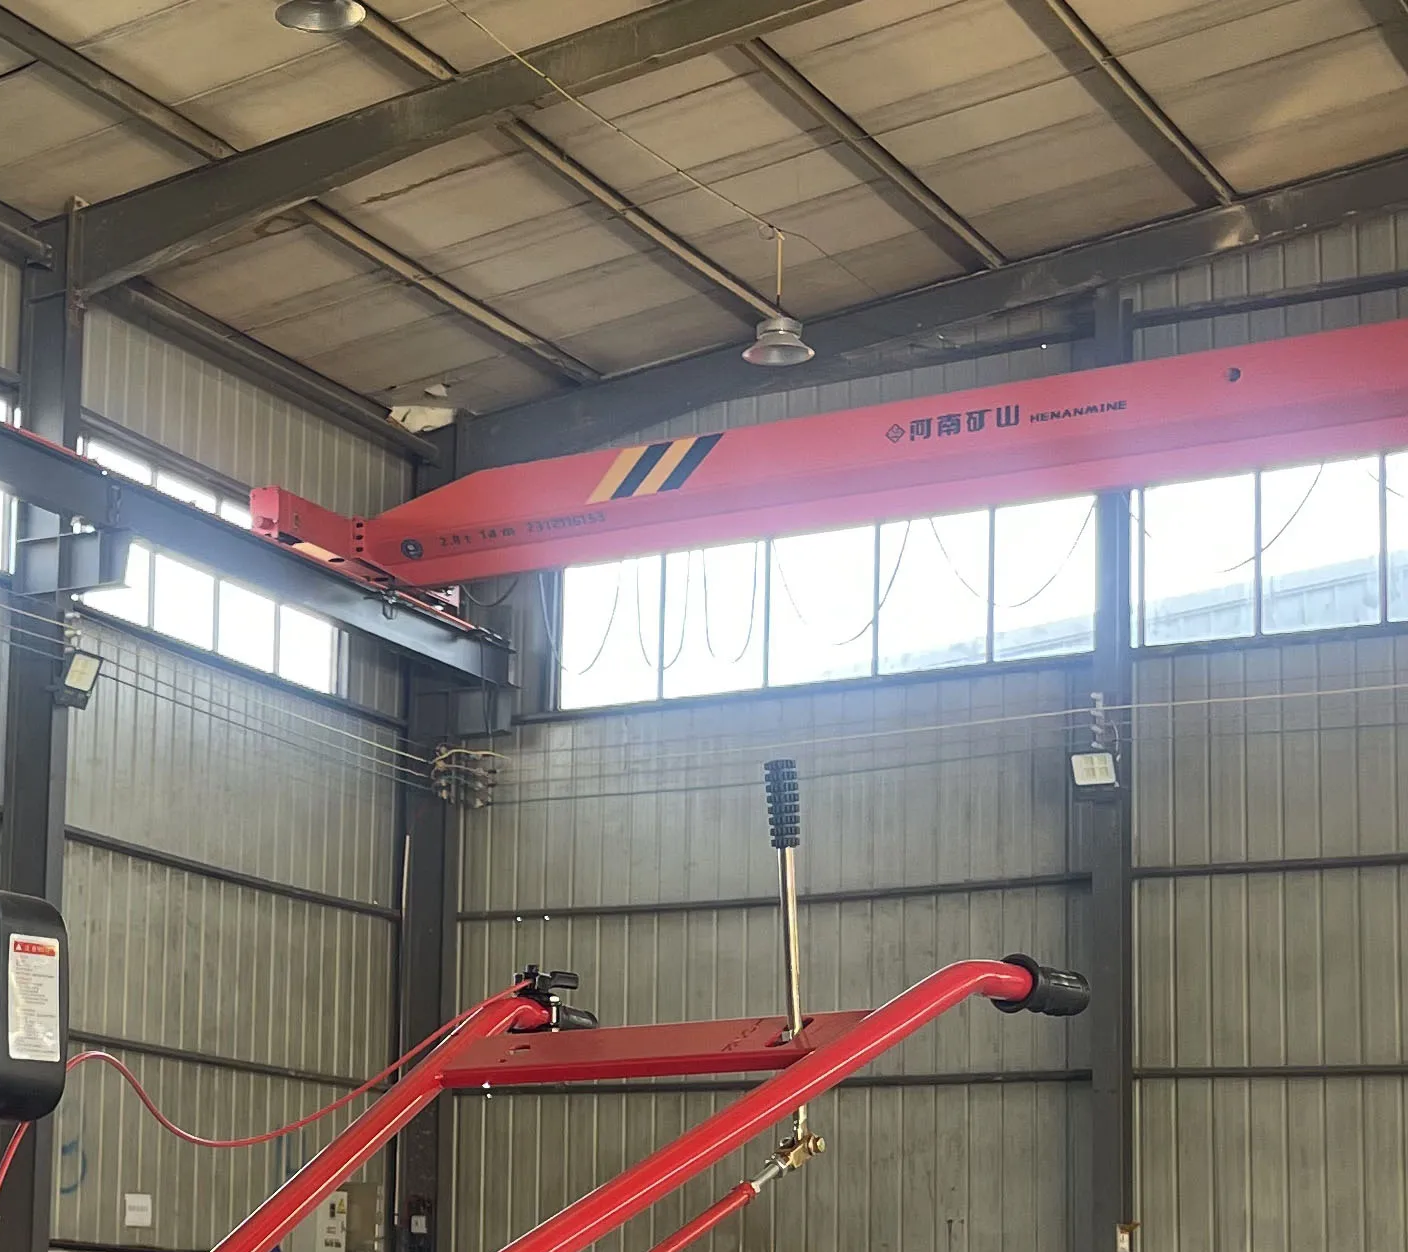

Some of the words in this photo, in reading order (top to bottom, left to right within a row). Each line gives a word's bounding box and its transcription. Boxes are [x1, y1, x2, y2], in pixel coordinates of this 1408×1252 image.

[909, 404, 1021, 442] 河南矿山
[1029, 400, 1128, 424] HENANMINE
